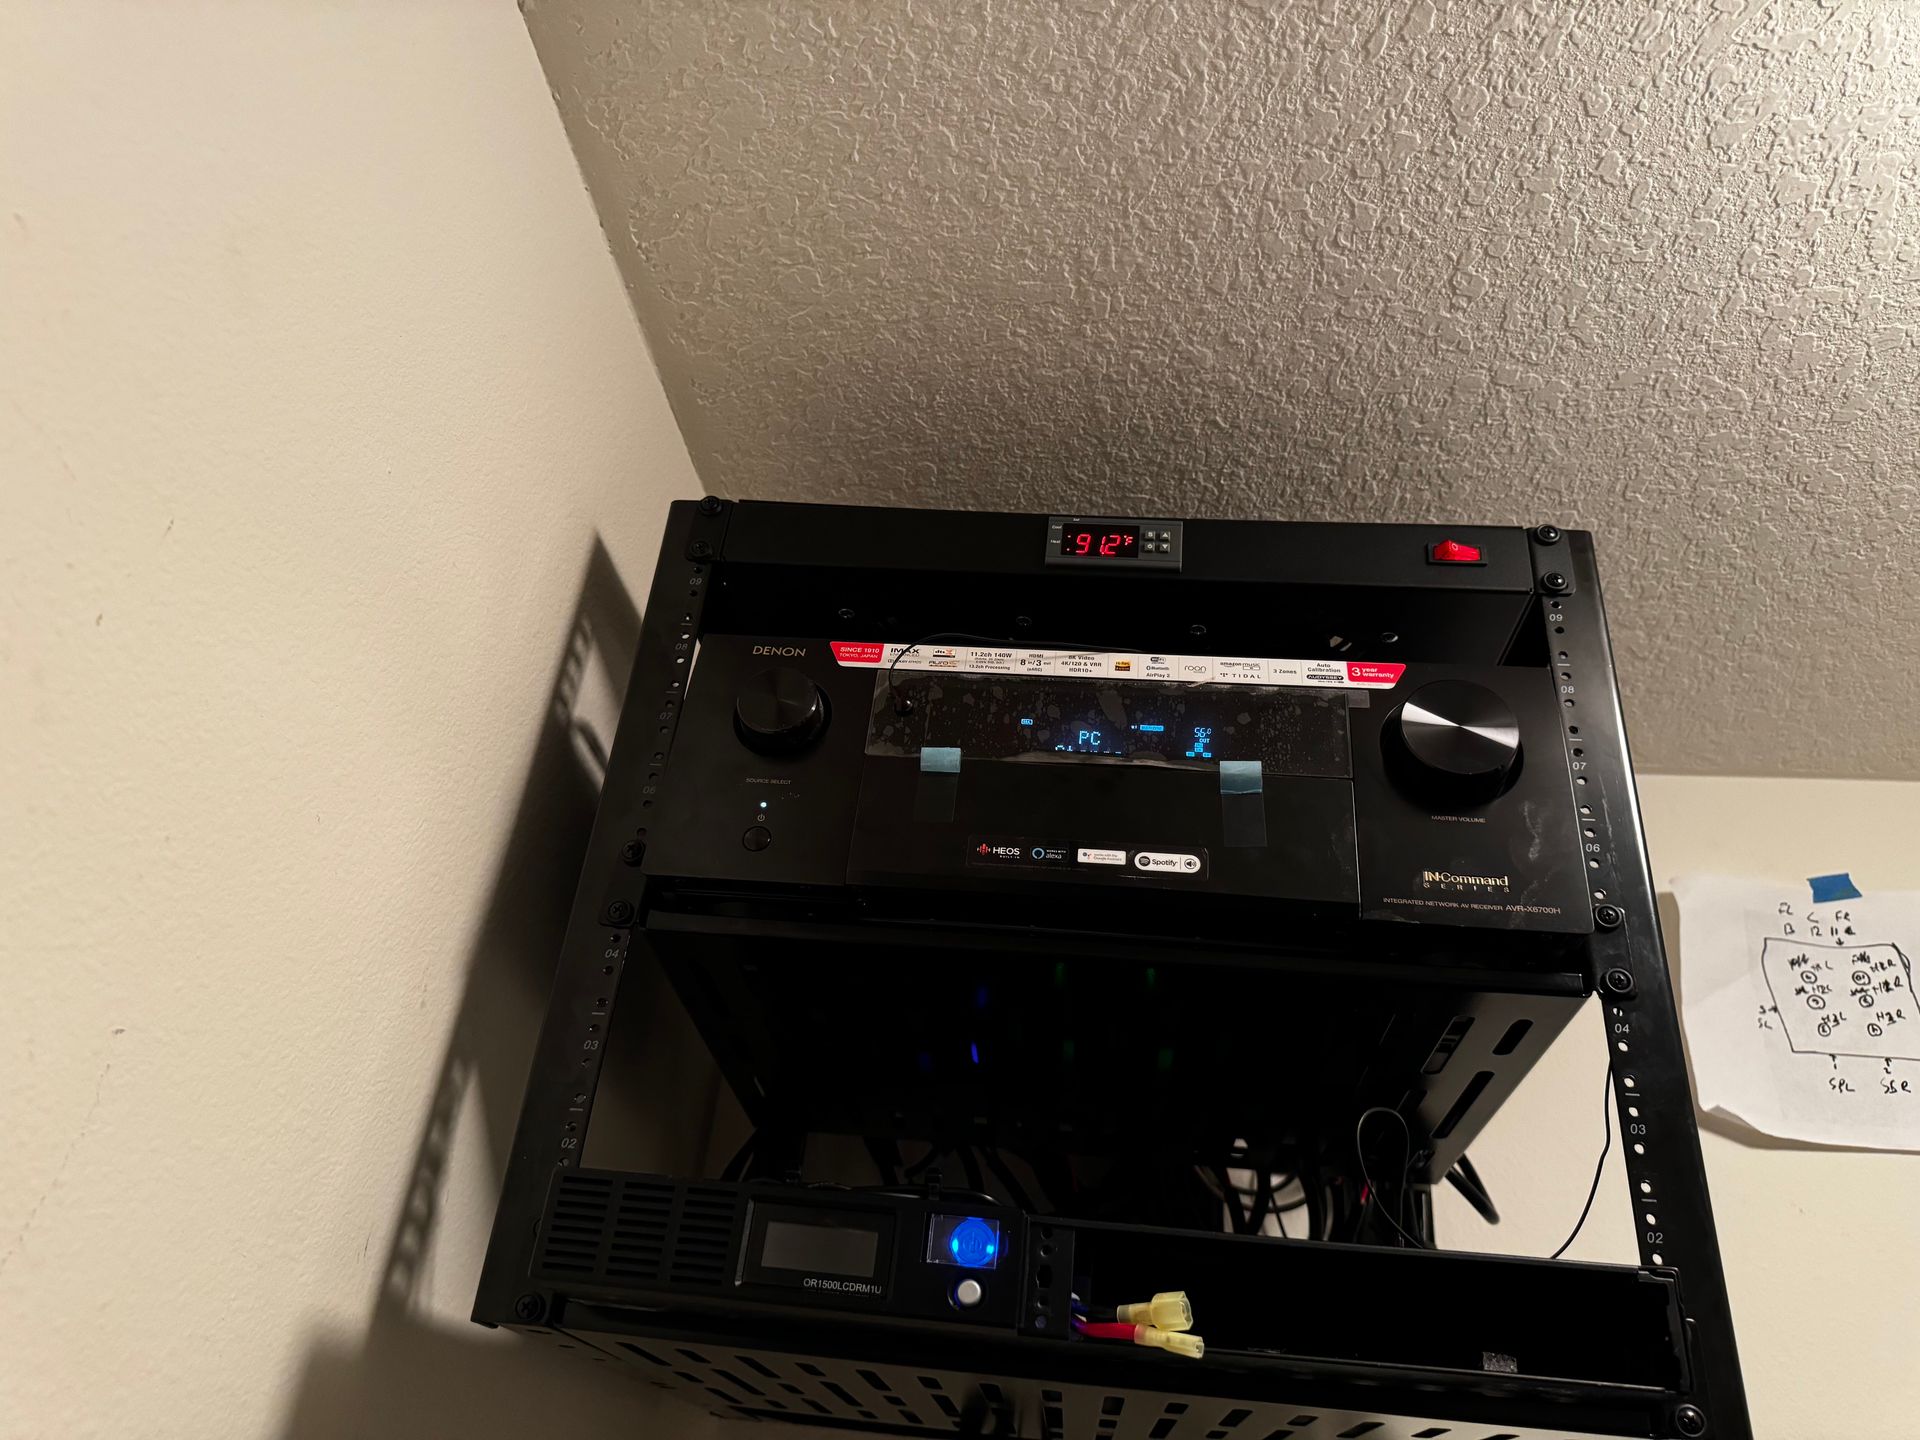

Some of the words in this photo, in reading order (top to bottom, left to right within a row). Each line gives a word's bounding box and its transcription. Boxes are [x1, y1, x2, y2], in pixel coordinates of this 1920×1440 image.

[690, 577, 702, 586] 09
[1549, 613, 1564, 622] 09
[752, 646, 807, 657] DENON
[1352, 667, 1360, 676] 3
[1560, 686, 1575, 694] 08
[659, 712, 673, 720] 07
[1079, 730, 1100, 745] PC
[1572, 762, 1587, 770] 07
[992, 846, 1020, 856] HEOS
[1586, 844, 1600, 853] 06
[1152, 858, 1176, 867] Spotify
[1424, 883, 1510, 893] SERIES
[1383, 898, 1424, 906] INTEGRATED
[1505, 904, 1561, 914] AVR-X6700H
[605, 948, 620, 958] 04
[1614, 1024, 1630, 1034] 04
[584, 1040, 600, 1050] 03
[1630, 1124, 1646, 1135] 03
[561, 1138, 578, 1150] 02
[1646, 1232, 1664, 1244] 02
[803, 1278, 882, 1294] OR1500LCDRM1U
